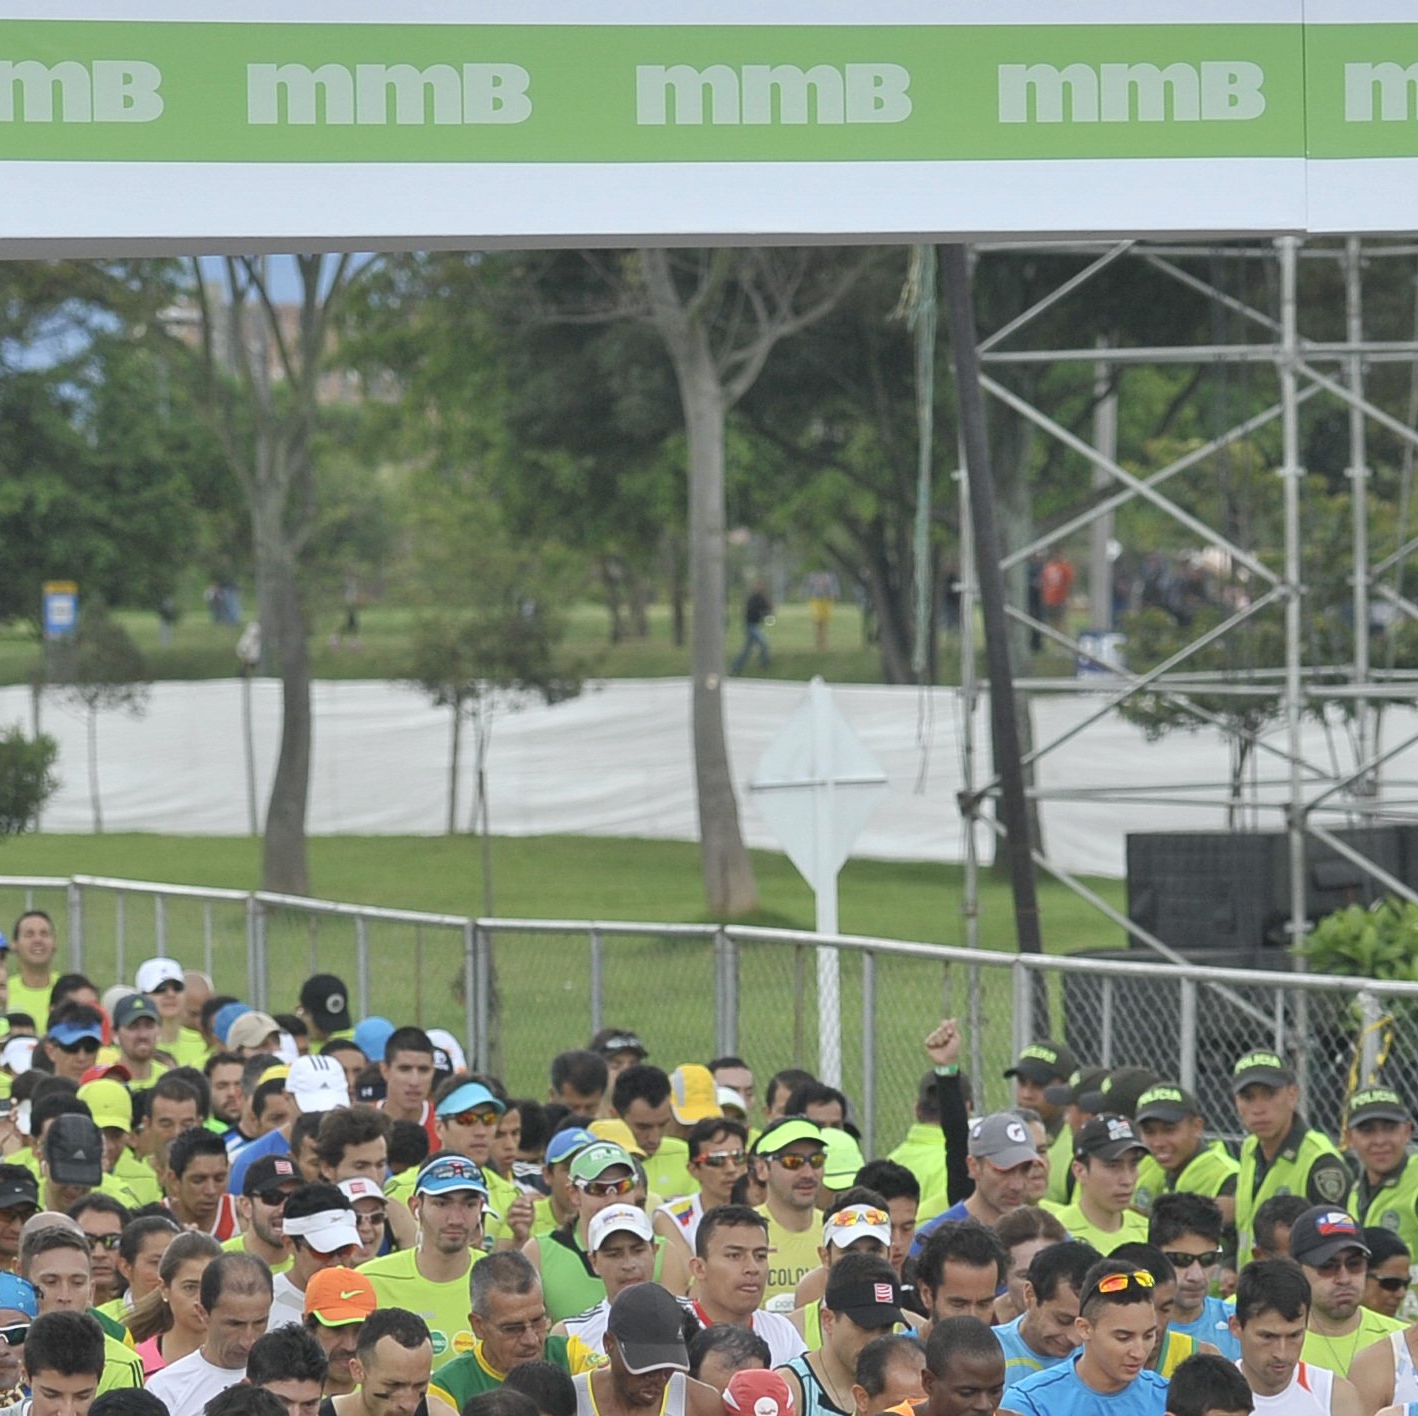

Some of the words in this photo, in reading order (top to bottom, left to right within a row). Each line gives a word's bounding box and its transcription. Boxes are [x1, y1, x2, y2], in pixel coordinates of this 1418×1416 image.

[246, 61, 533, 125] mmB
[636, 62, 913, 125] mmB
[998, 60, 1265, 123] mmB
